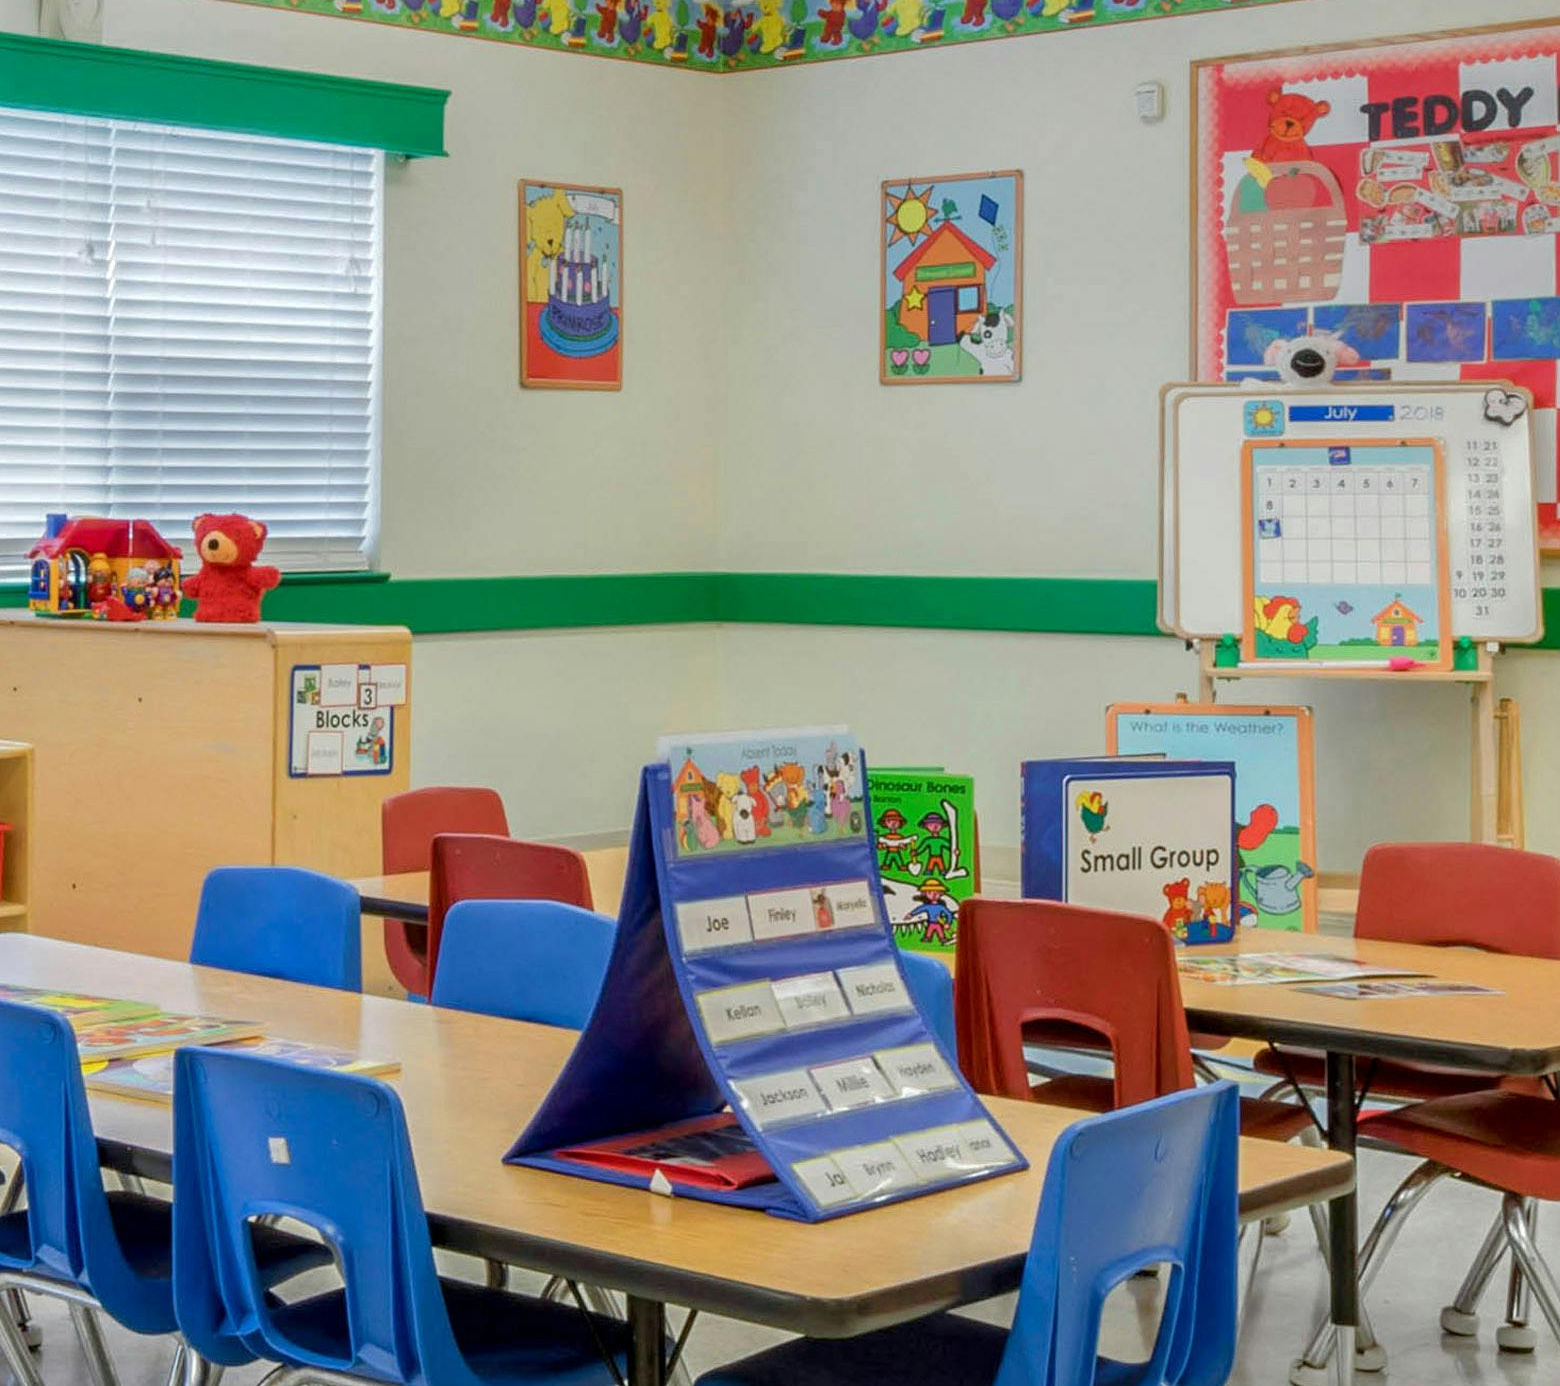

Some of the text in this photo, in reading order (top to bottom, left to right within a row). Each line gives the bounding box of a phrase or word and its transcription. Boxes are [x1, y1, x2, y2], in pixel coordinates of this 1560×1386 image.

[1359, 85, 1534, 140] TEDDY
[1323, 406, 1358, 421] July
[1399, 405, 1445, 421] 2018
[1466, 441, 1498, 451] 11 21
[1466, 457, 1498, 467] 12 22
[1266, 478, 1419, 488] 1 2 3 4 5 6 7
[1467, 473, 1499, 483] 13 23
[1468, 489, 1500, 499] 14 24
[1469, 506, 1500, 516] 15 25
[1470, 522, 1502, 532] 16 26
[1470, 538, 1502, 548] 17 27
[1470, 555, 1505, 565] 18 28
[1455, 570, 1506, 581] 9 19 29
[1453, 587, 1506, 599] 10 20 30
[1475, 605, 1490, 616] 31
[363, 688, 373, 705] 3
[315, 709, 369, 729] Blocks
[1129, 721, 1285, 735] What is the Weather?
[867, 779, 966, 795] Dinosaur Bones
[1080, 846, 1220, 873] Small Group
[705, 916, 730, 933] Joe
[767, 908, 797, 924] Finley
[726, 1004, 762, 1022] Kellan
[855, 982, 896, 998] Nicholas
[760, 1085, 809, 1107] Jackson
[825, 1171, 845, 1189] Ja
[916, 1143, 963, 1163] Hadley
